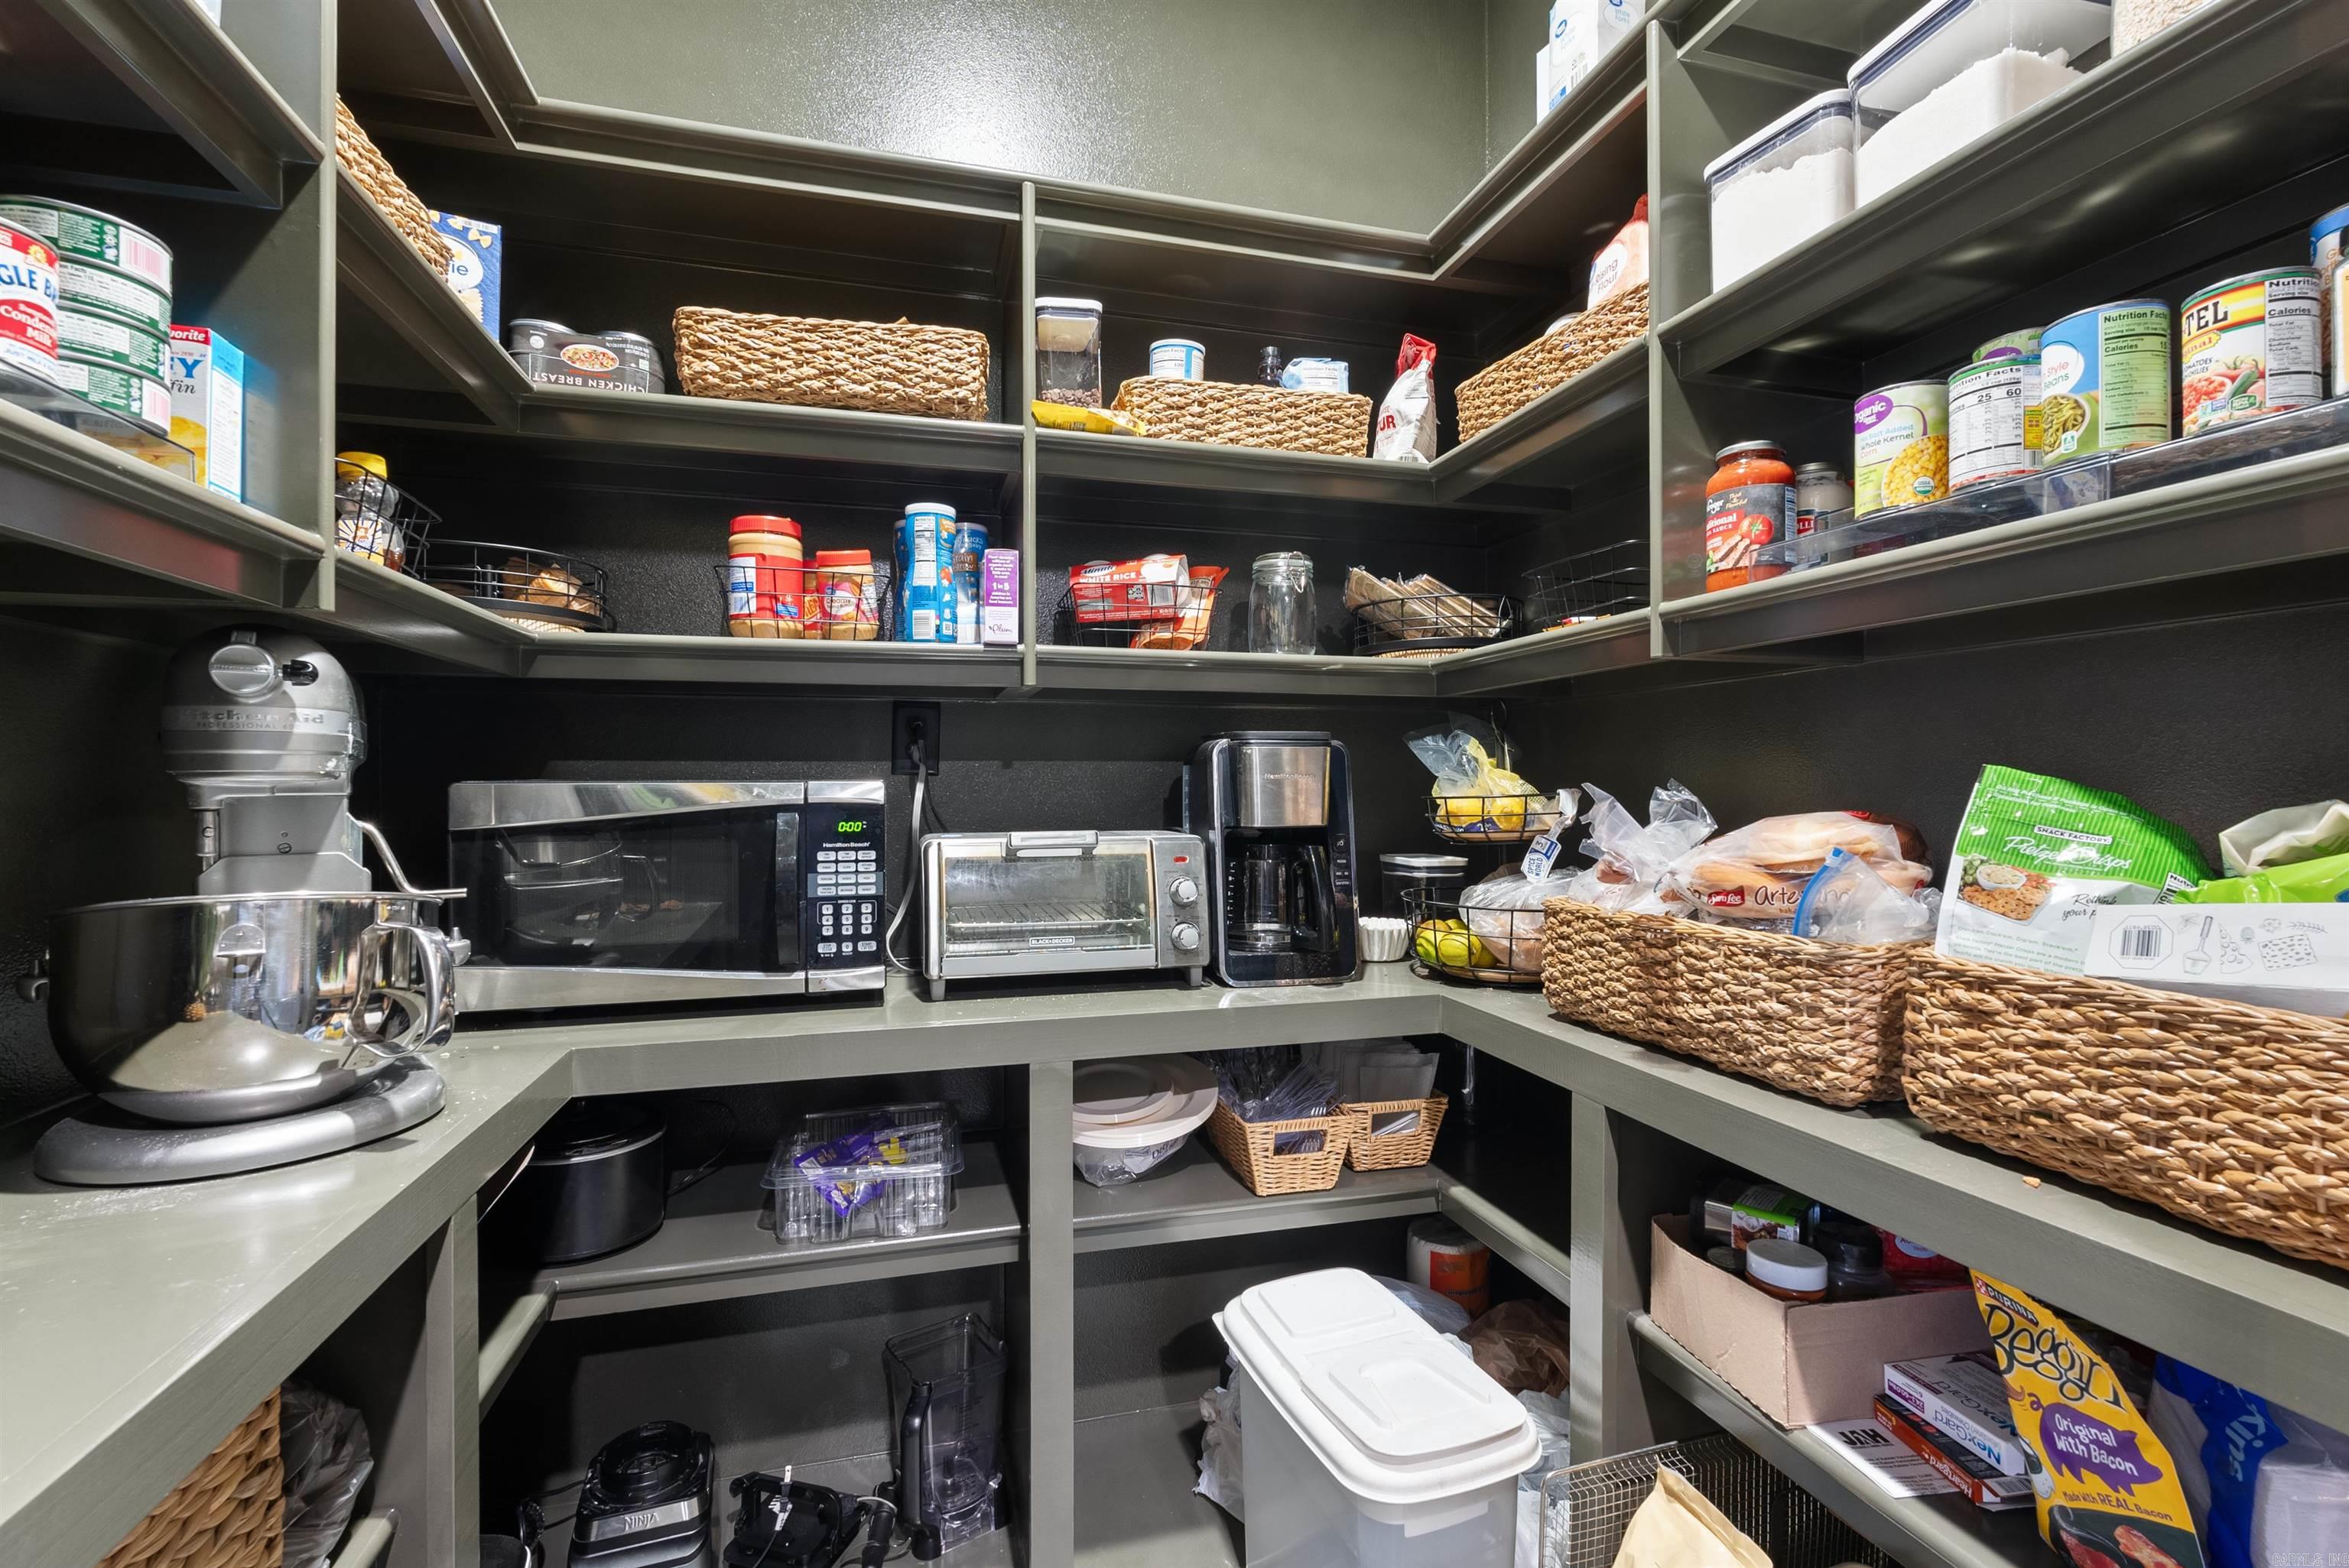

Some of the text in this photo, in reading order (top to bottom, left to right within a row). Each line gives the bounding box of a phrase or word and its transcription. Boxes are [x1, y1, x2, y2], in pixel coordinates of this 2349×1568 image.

[2104, 311, 2147, 323] Nutrition
[2268, 307, 2311, 317] Calories
[26, 326, 53, 348] Milk
[2104, 343, 2138, 352] Calories
[531, 372, 583, 386] BREAST
[1986, 368, 2022, 378] Facts
[587, 378, 645, 394] CHICKEN
[1977, 387, 2022, 403] 25 60
[1885, 424, 1914, 434] Added
[1883, 431, 1914, 443] Kernel
[1860, 448, 1878, 459] Corn
[1079, 572, 1136, 583] WHITE RICE
[992, 623, 1013, 635] Plum
[838, 821, 863, 832] 0:00
[2036, 826, 2065, 837] SNACK
[1527, 857, 1543, 877] SPICE WORLD
[1707, 893, 1744, 905] Sara Lee
[2062, 908, 2088, 921] your
[1987, 1286, 2038, 1323] PURINA
[1932, 1380, 2018, 1438] NexGard
[2055, 1413, 2117, 1447] Original
[1837, 1428, 1891, 1446] JAH
[1934, 1409, 2002, 1466] NexGard
[2053, 1432, 2139, 1477] With Bacon
[1928, 1457, 1972, 1498] Heartgard
[2062, 1491, 2081, 1502] Made
[2096, 1492, 2135, 1512] REAL
[2134, 1504, 2173, 1521] Bacon
